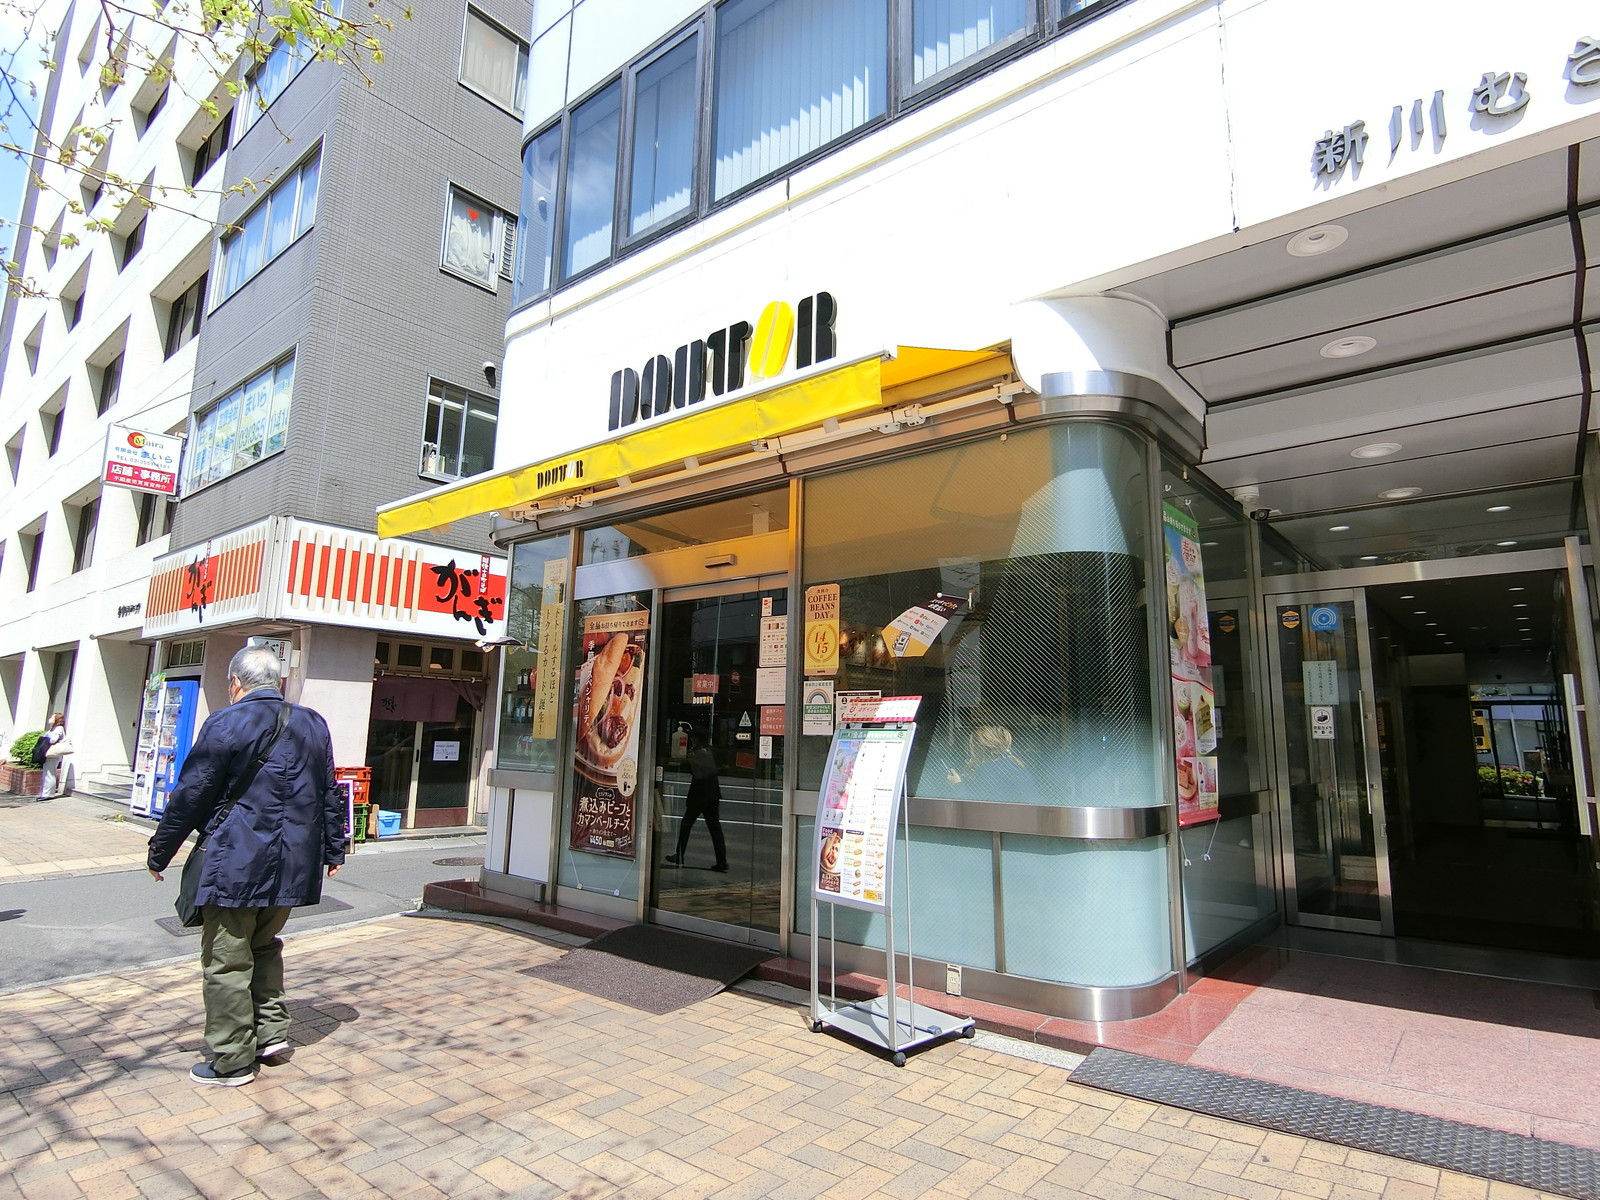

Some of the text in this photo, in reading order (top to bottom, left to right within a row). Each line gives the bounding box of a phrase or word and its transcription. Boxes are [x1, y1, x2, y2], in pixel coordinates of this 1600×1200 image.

[608, 291, 837, 432] DOUTOR
[140, 450, 173, 464] まいら
[111, 464, 172, 484] 店舗・事務所
[537, 459, 583, 490] DOUTOR
[808, 593, 838, 604] COFFEE
[810, 602, 835, 611] BEANS
[814, 611, 830, 620] DAY
[814, 630, 826, 643] 14
[816, 642, 828, 654] 15
[696, 680, 714, 688] 営業中
[579, 796, 632, 817] 煮込みビーフと
[577, 813, 630, 831] カマンベールチーズ
